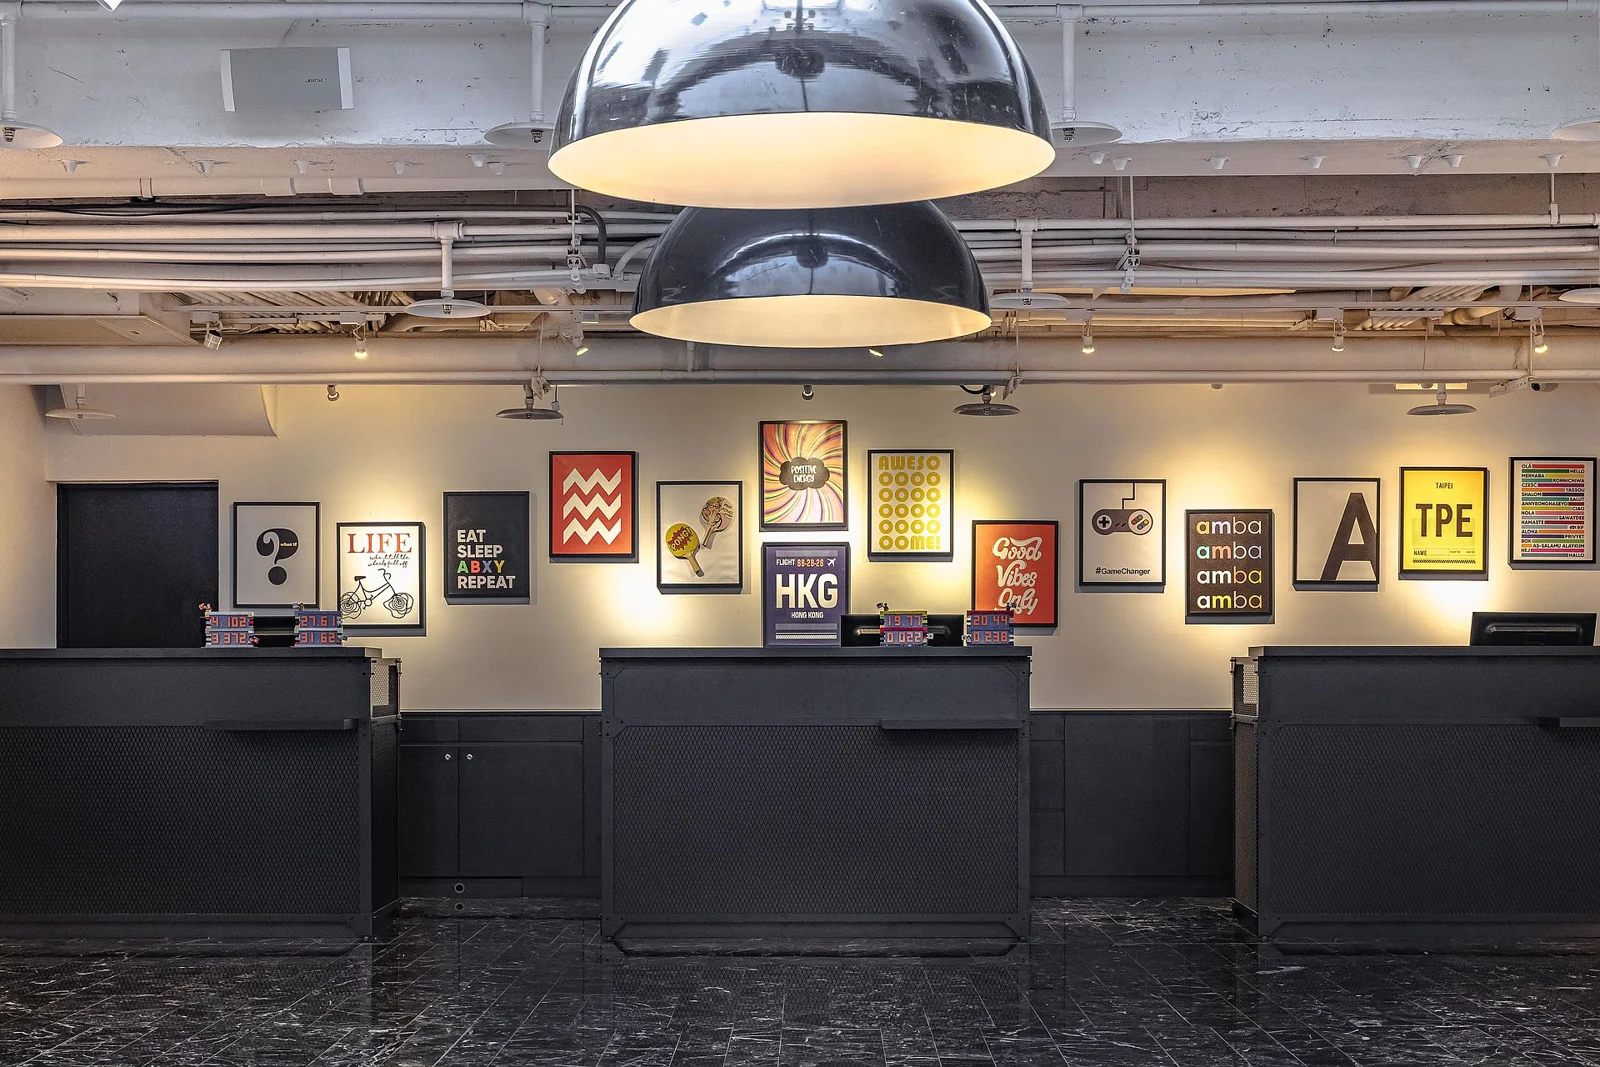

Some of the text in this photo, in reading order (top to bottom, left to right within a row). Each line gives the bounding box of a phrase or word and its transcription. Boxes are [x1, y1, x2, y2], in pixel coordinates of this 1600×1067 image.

[790, 465, 817, 474] POSITIVE
[793, 474, 815, 483] ENERGY
[1435, 482, 1454, 490] TAIPEI
[1196, 516, 1262, 535] amba
[1415, 503, 1473, 538] TPE
[347, 532, 413, 554] LIFE
[457, 529, 486, 543] EAT
[670, 526, 693, 552] PONG!
[457, 544, 503, 558] SLEEP
[992, 536, 1043, 561] Good
[1196, 541, 1262, 560] amba
[456, 560, 505, 574] ABXY
[775, 558, 796, 566] FLIGHT
[995, 559, 1038, 588] Vibes
[1095, 566, 1151, 577] #GameChanger
[1196, 566, 1262, 584] amba
[457, 575, 516, 589] REPEAT
[775, 573, 838, 609] HKG
[997, 587, 1039, 616] Only
[1196, 590, 1263, 609] amba
[790, 611, 824, 619] HONG KONG
